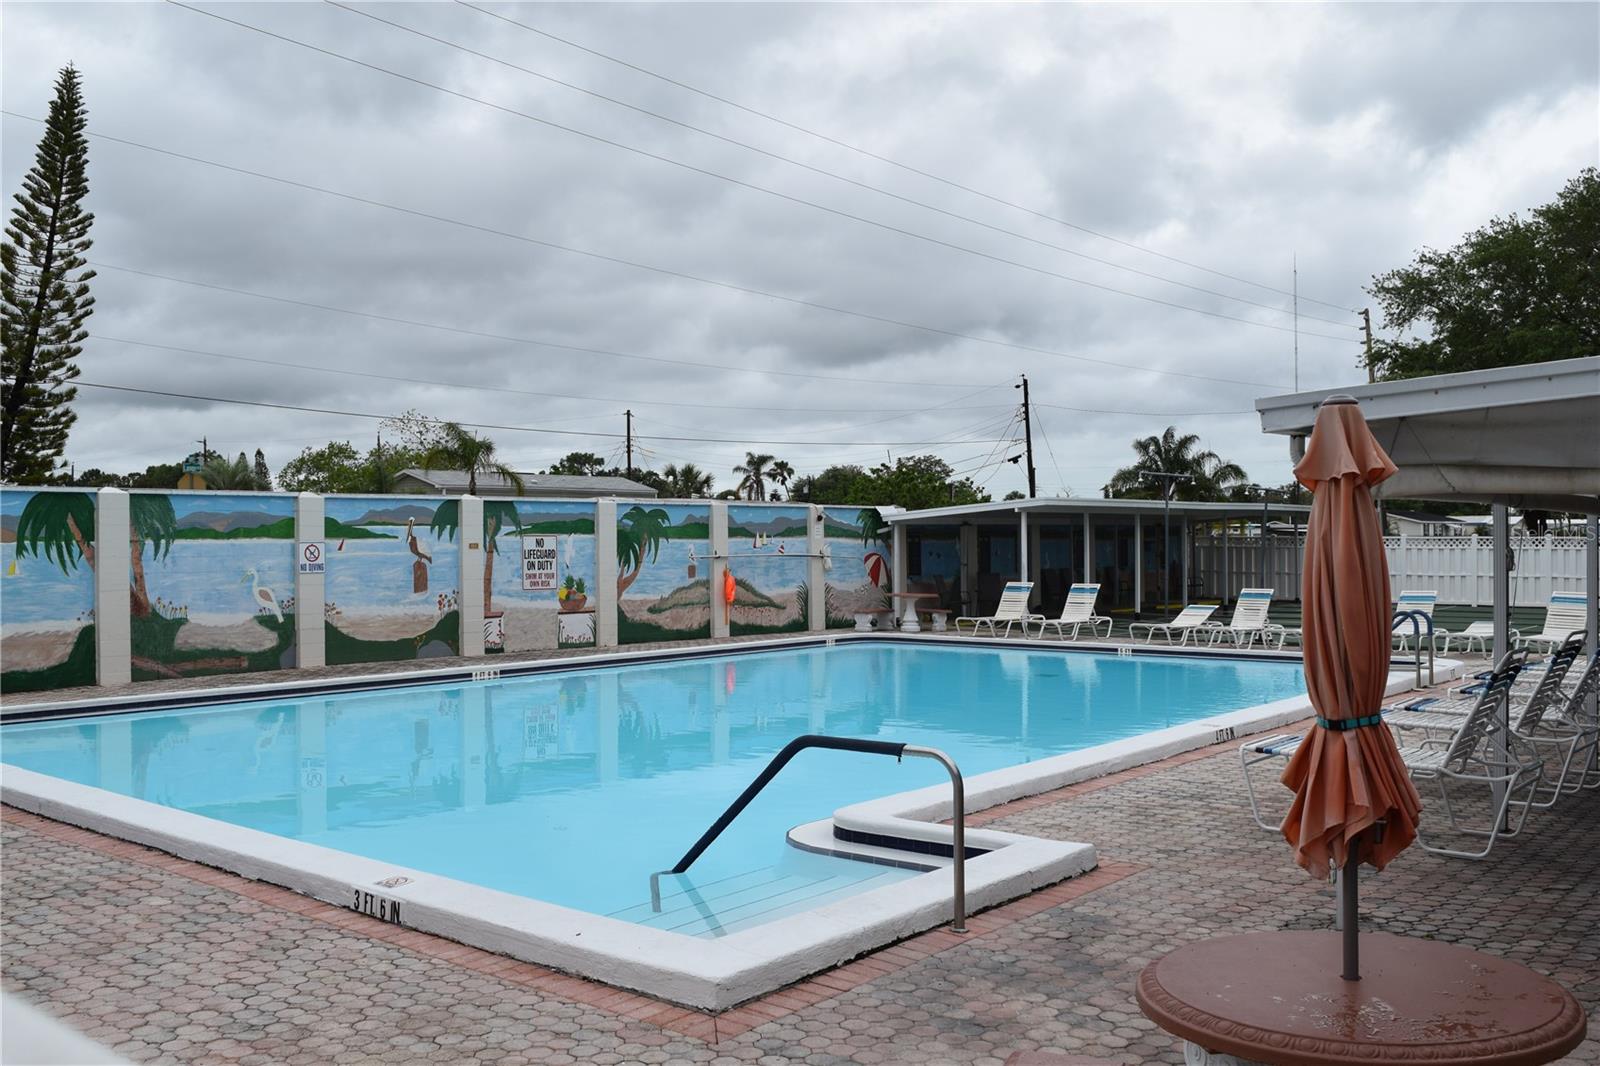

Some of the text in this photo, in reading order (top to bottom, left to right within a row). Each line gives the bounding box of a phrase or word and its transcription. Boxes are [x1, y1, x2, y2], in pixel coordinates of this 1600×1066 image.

[535, 538, 545, 548] NO
[523, 549, 556, 559] LIFEGUARD
[300, 563, 324, 571] NO DIVING
[526, 560, 554, 570] ON DUTY
[353, 889, 360, 910] 3
[380, 898, 386, 920] 6
